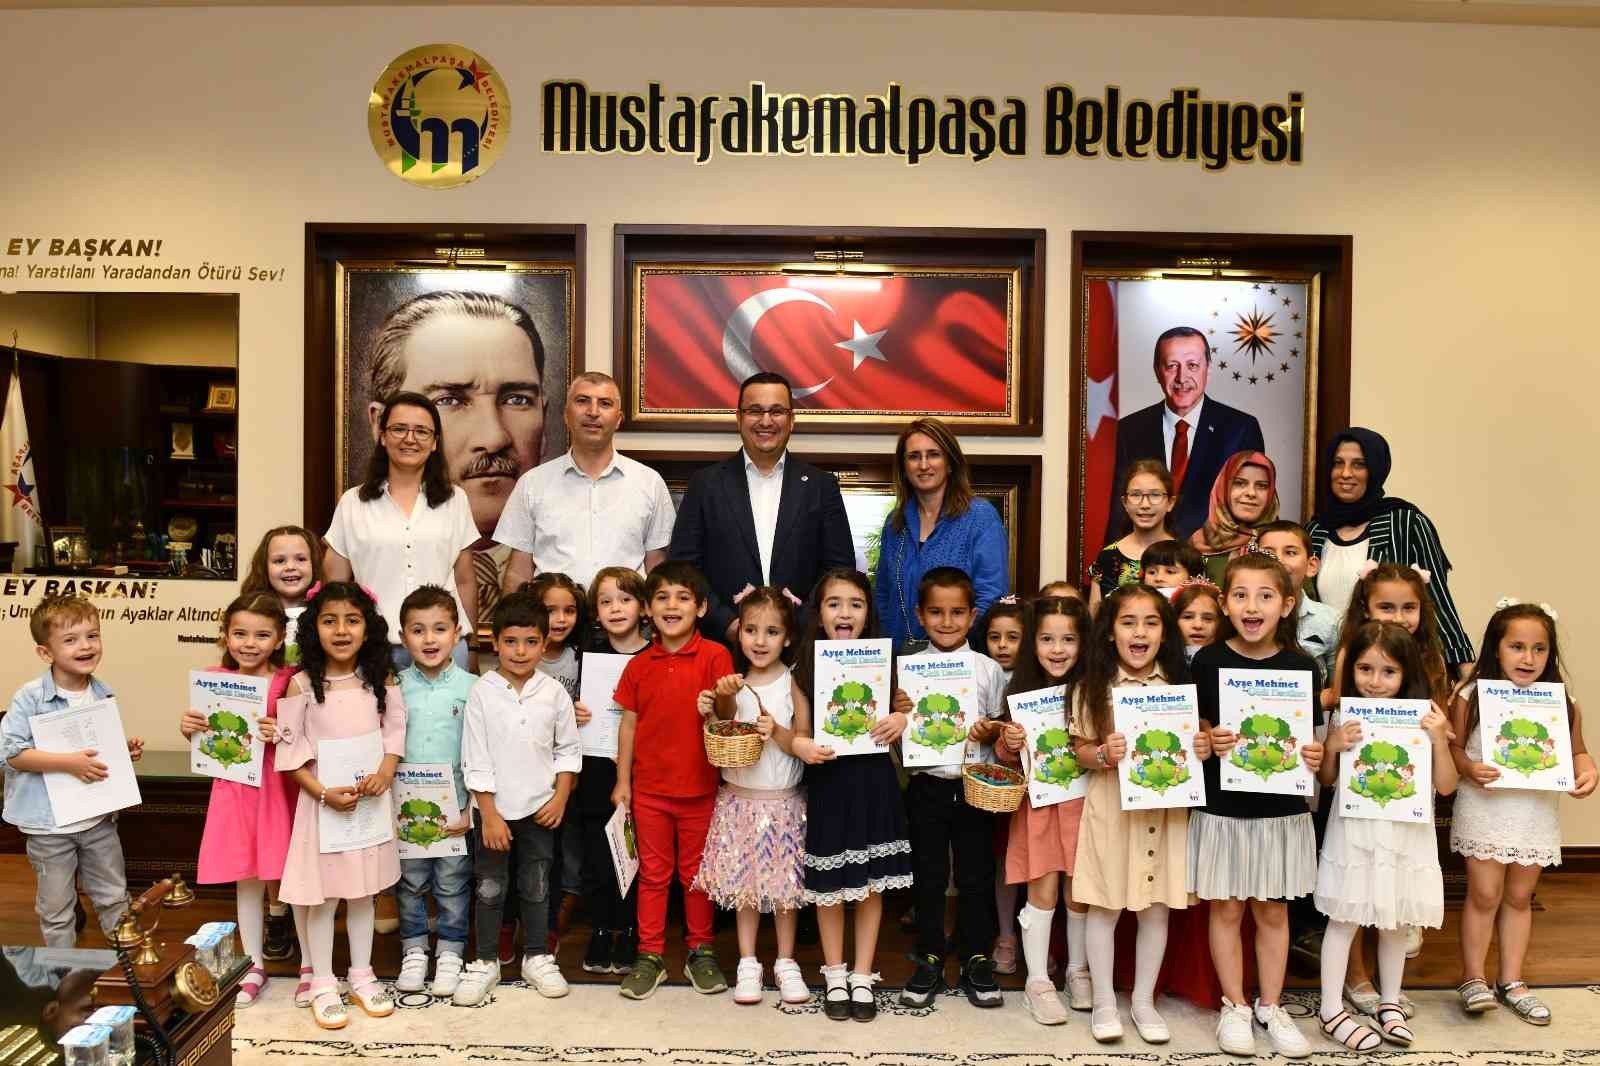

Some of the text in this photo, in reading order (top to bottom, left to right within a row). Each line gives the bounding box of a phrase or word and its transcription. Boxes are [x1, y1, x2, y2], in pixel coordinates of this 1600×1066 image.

[541, 80, 1304, 171] Mustafakemalpaşa Belediyesi
[7, 238, 163, 262] EY BAŞKAN!
[27, 264, 96, 280] Yaratılanı
[102, 264, 191, 280] Yaradandan
[197, 261, 242, 281] Ötürü
[247, 266, 286, 282] Sev!
[3, 578, 37, 596] EY
[121, 605, 175, 625] Ayaklar
[822, 647, 881, 658] Ayşe Mehmet
[903, 660, 965, 673] Ayşe Mehmet
[195, 678, 257, 693] Ayşe Mehmet
[1226, 678, 1299, 689] Ayşe Mehmet
[1487, 687, 1553, 698] Ayşe Mehmet
[1016, 700, 1040, 711] Ayşe
[1120, 694, 1187, 706] Ayşe Mehmet
[1348, 706, 1418, 717] Ayşe Mehmet
[407, 770, 444, 779] Mehmet
